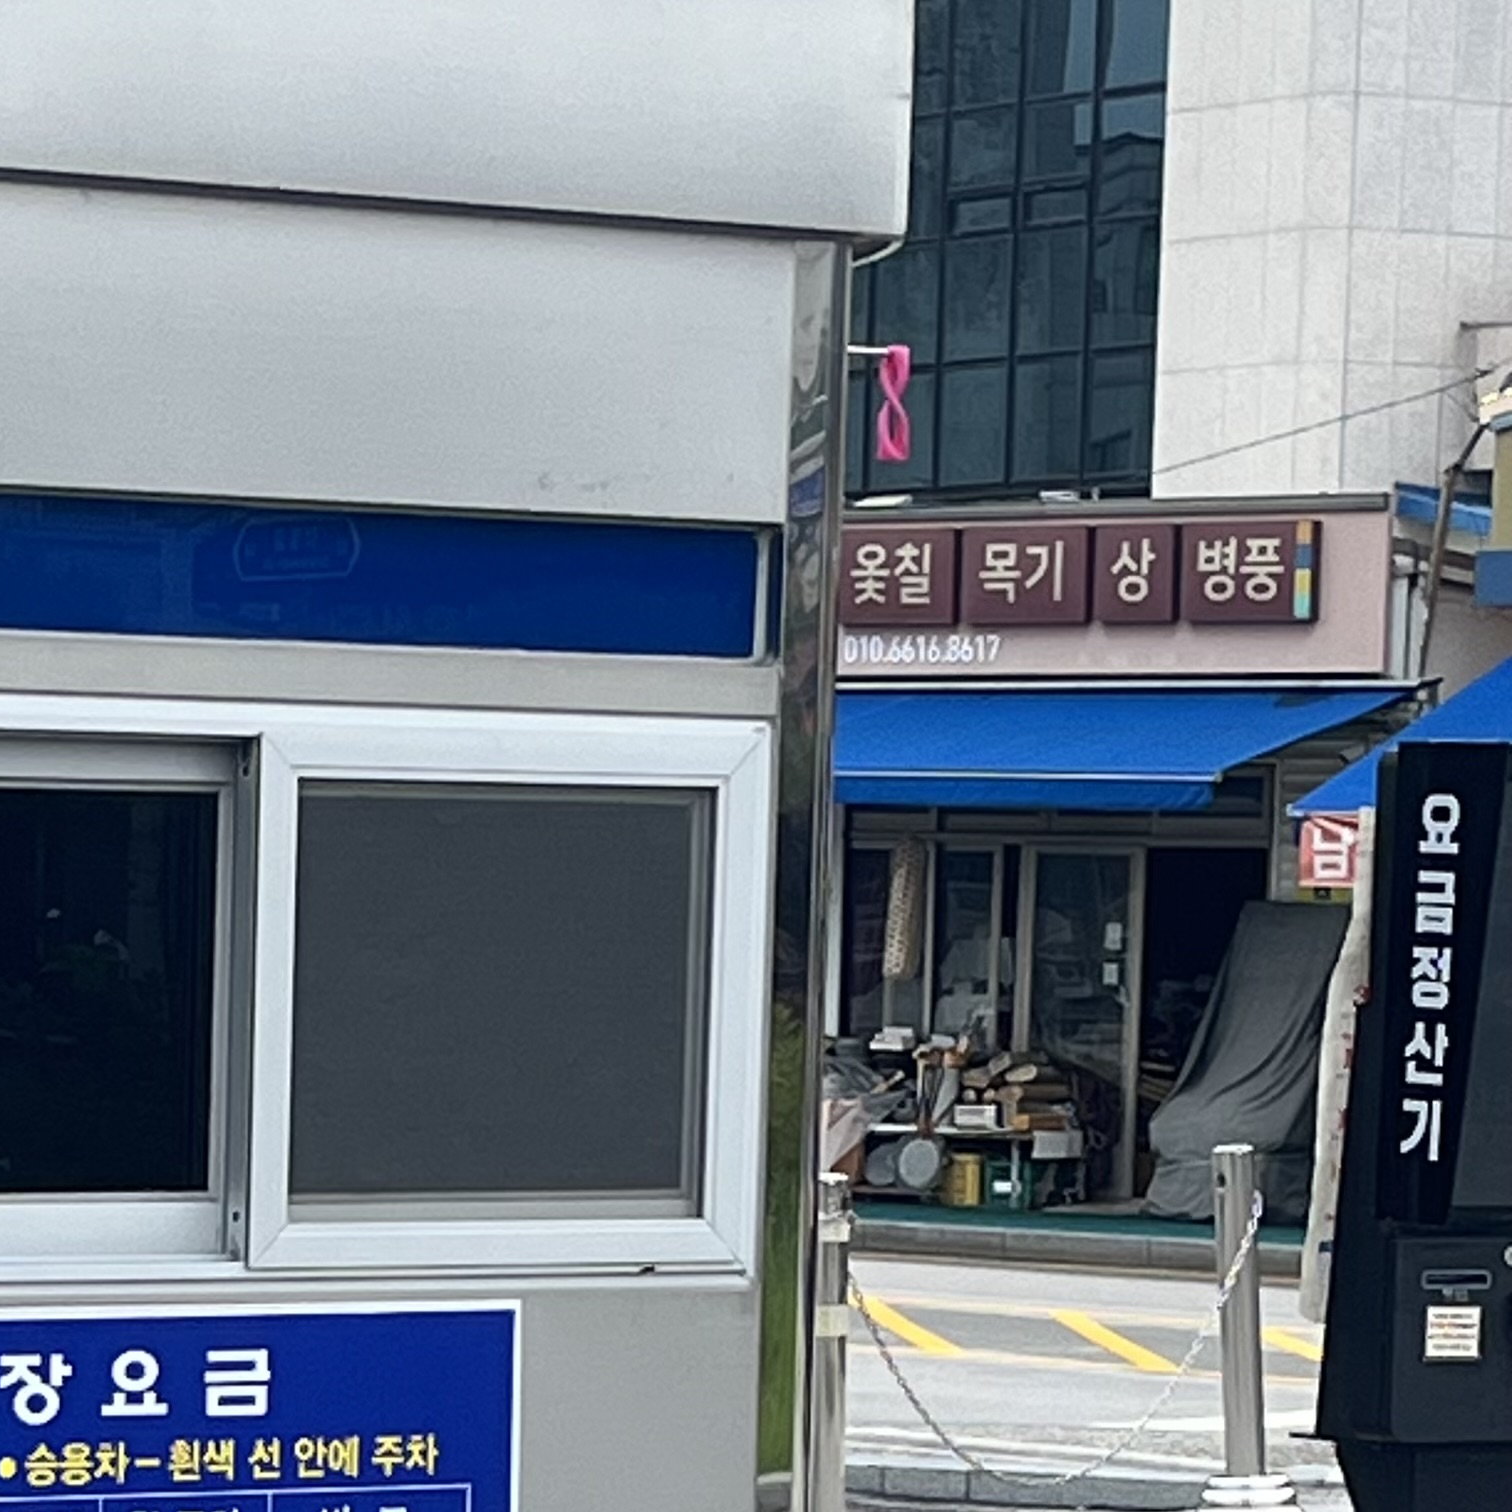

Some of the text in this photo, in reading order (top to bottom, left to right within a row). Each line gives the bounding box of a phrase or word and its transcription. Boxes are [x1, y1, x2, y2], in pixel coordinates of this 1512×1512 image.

[849, 536, 1285, 606] 옻칠 목기 상 병풍
[843, 634, 1001, 664] 010.6616.8617
[1399, 792, 1462, 1163] 요금정산기
[249, 1437, 282, 1480] 선
[294, 1434, 361, 1479] 안에
[371, 1432, 439, 1477] 주차
